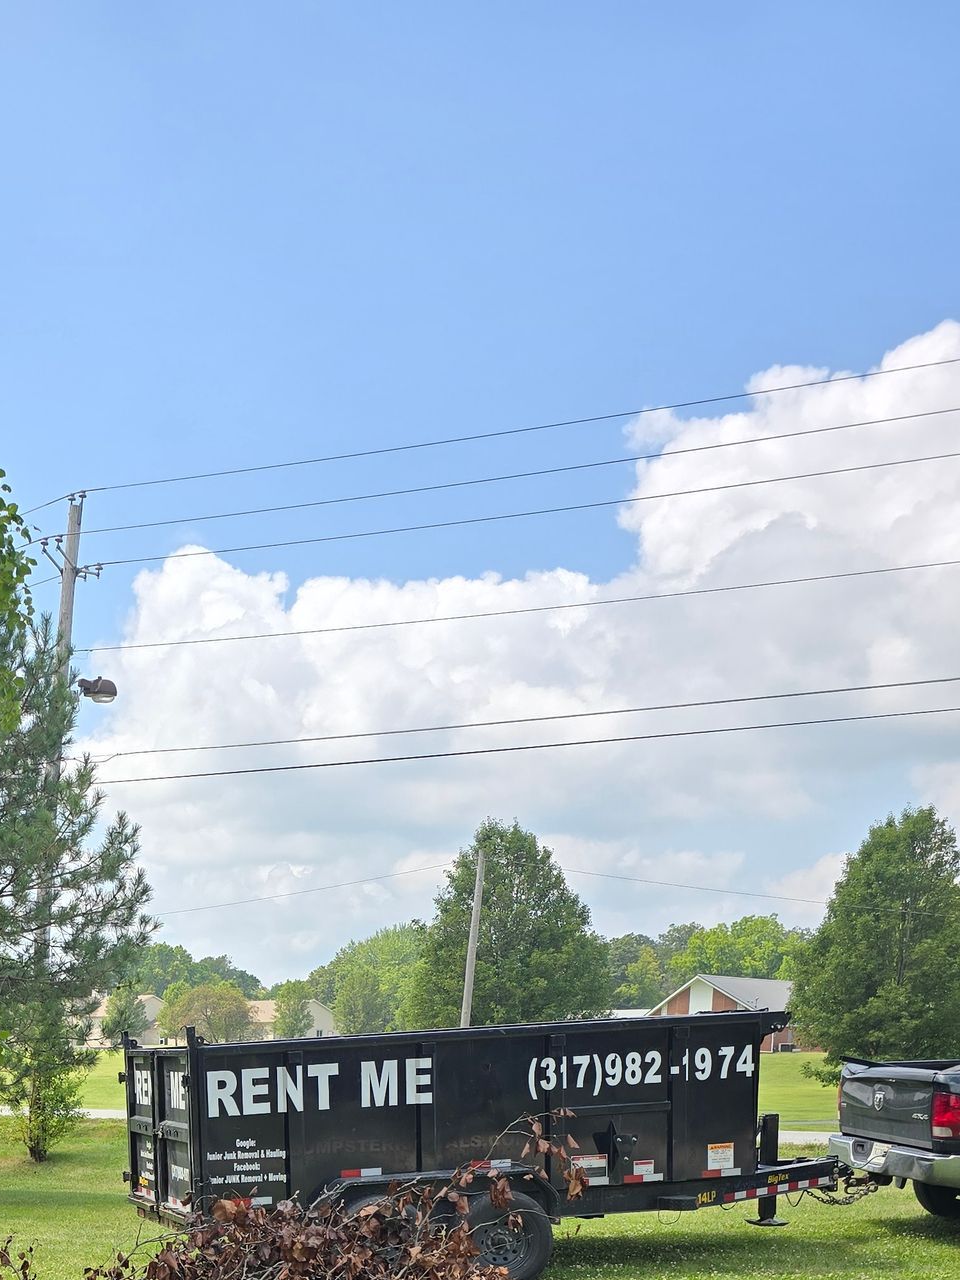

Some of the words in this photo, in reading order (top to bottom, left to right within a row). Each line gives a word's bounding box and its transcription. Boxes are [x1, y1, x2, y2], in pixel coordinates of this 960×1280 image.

[206, 1062, 340, 1118] RENT
[360, 1057, 433, 1108] ME
[235, 1138, 257, 1149] Google:
[223, 1150, 237, 1161] Junk
[237, 1149, 260, 1160] Removal
[260, 1148, 265, 1159] &
[265, 1147, 287, 1160] Hauling
[233, 1161, 261, 1172] Facebook:
[224, 1174, 240, 1184] JUNK
[241, 1173, 263, 1183] Removal
[268, 1172, 287, 1183] Moving
